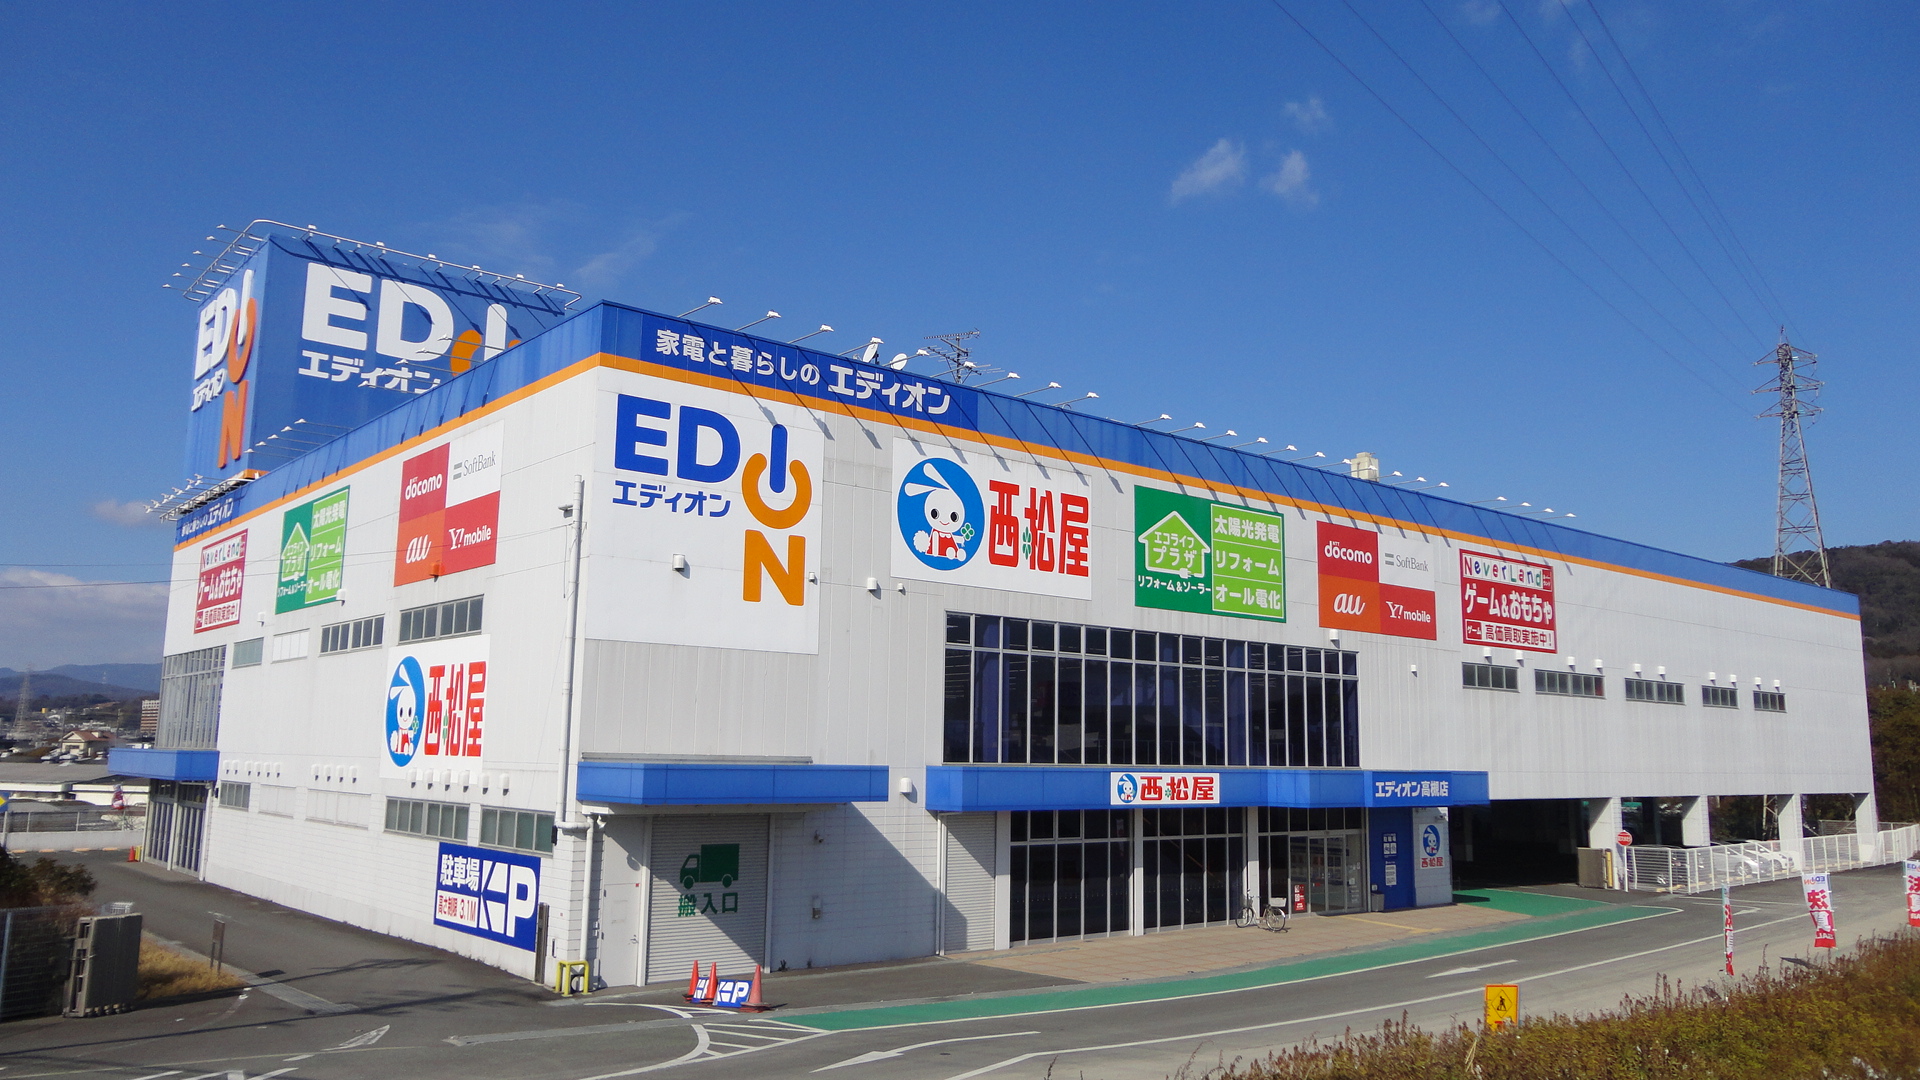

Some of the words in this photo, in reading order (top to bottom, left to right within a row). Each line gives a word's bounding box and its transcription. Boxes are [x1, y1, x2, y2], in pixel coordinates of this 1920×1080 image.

[298, 350, 441, 394] エディオン
[655, 329, 820, 386] 家電と暮らしの
[828, 364, 950, 415] エディオン
[463, 451, 496, 477] SoftBank
[405, 474, 442, 500] docomo
[612, 480, 731, 517] エディオン
[614, 393, 812, 606] EDION
[988, 479, 1089, 577] 西松屋
[1154, 531, 1195, 549] エコライフ
[1214, 515, 1280, 543] 太陽光発電
[310, 536, 342, 562] リフォーム
[406, 534, 432, 564] au
[1153, 546, 1198, 568] プラザ
[1324, 541, 1372, 564] docomo
[1216, 550, 1279, 576] リフォーム
[1396, 555, 1428, 572] SoftBank
[1464, 556, 1541, 587] NeverLand
[306, 568, 340, 594] オール電化
[1138, 575, 1211, 594] リフォーム&ソーラー
[1215, 584, 1280, 610] オール電化
[1333, 593, 1366, 615] au
[1465, 583, 1552, 625] ゲーム&おもちゃ
[424, 660, 487, 757] 西松屋
[1140, 776, 1214, 801] 西松屋
[440, 854, 480, 891] 駐車場
[1421, 856, 1443, 868] 西松屋
[678, 892, 739, 917] 搬入口
